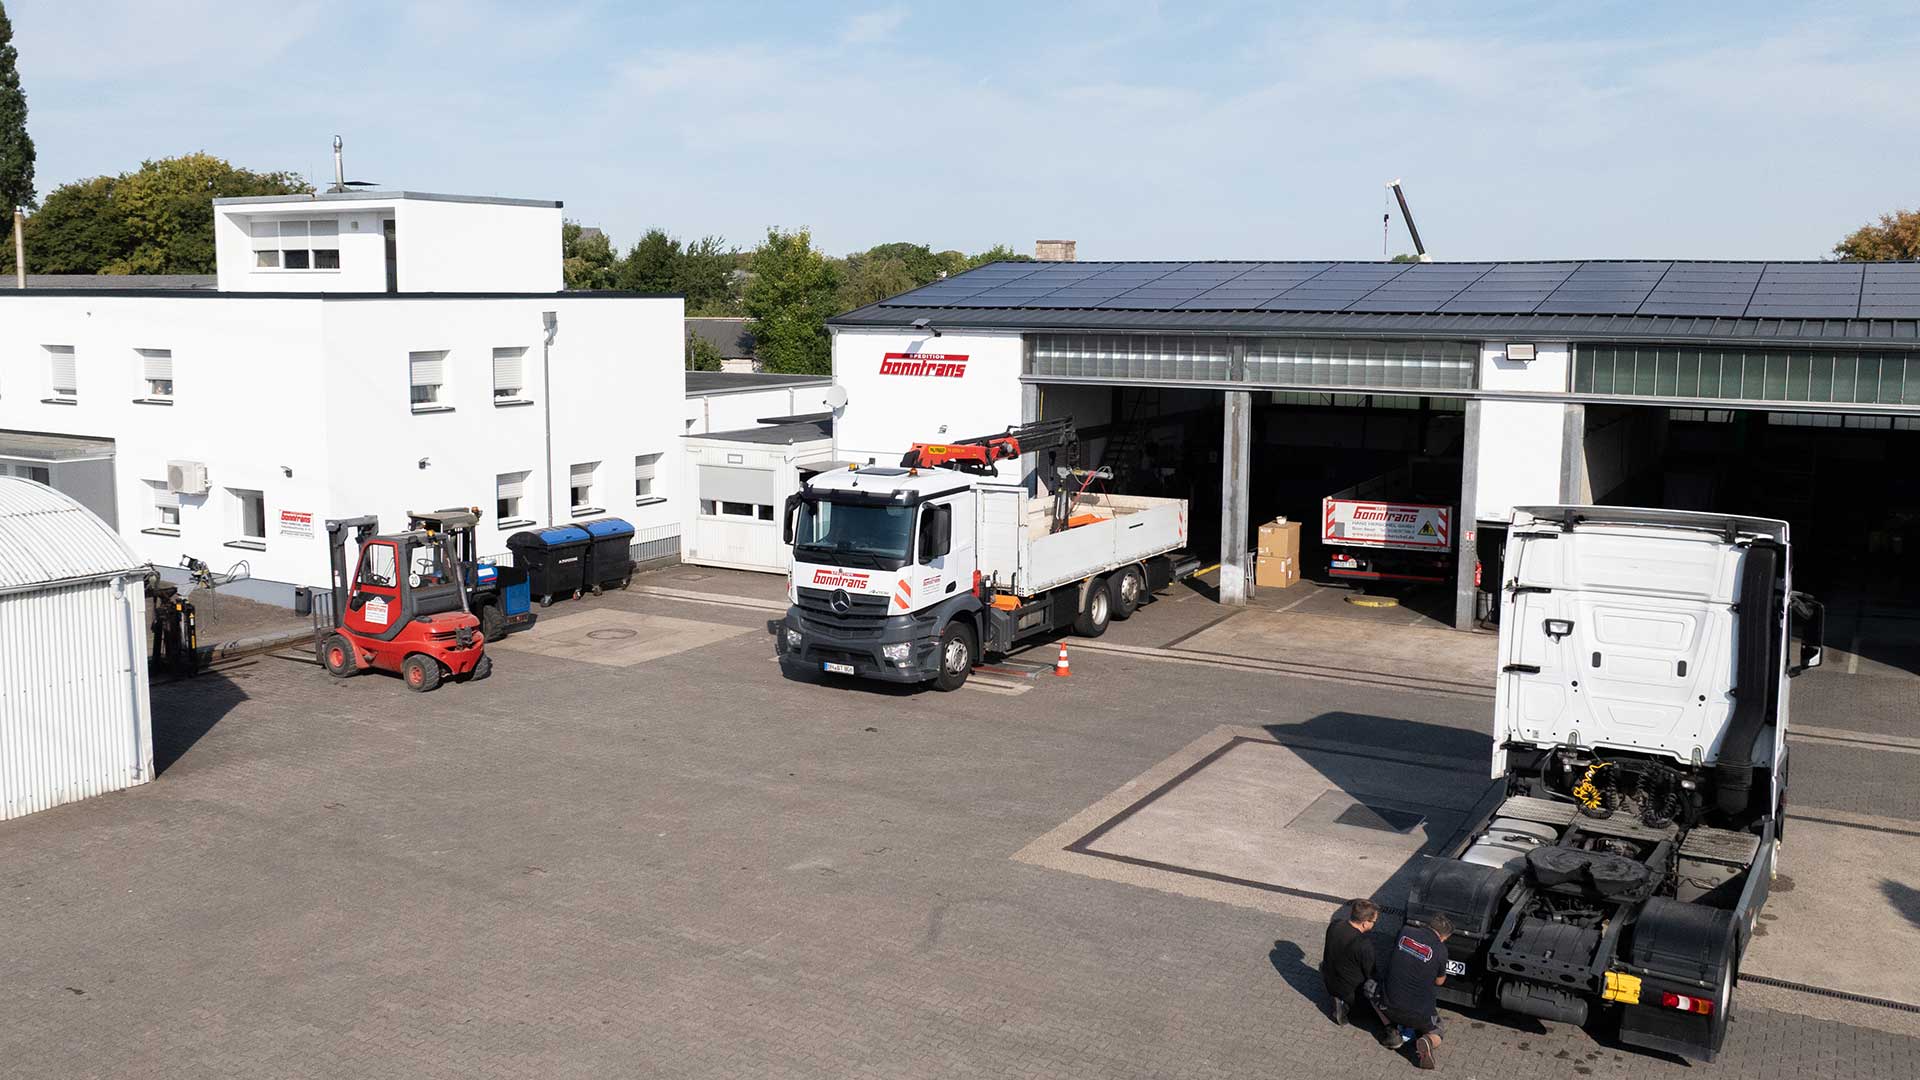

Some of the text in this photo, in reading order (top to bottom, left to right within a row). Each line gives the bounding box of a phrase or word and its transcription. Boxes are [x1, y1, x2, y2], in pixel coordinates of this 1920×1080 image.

[879, 353, 969, 378] bonntrans
[1353, 506, 1420, 523] bonntrans
[813, 570, 870, 589] bonntrans
